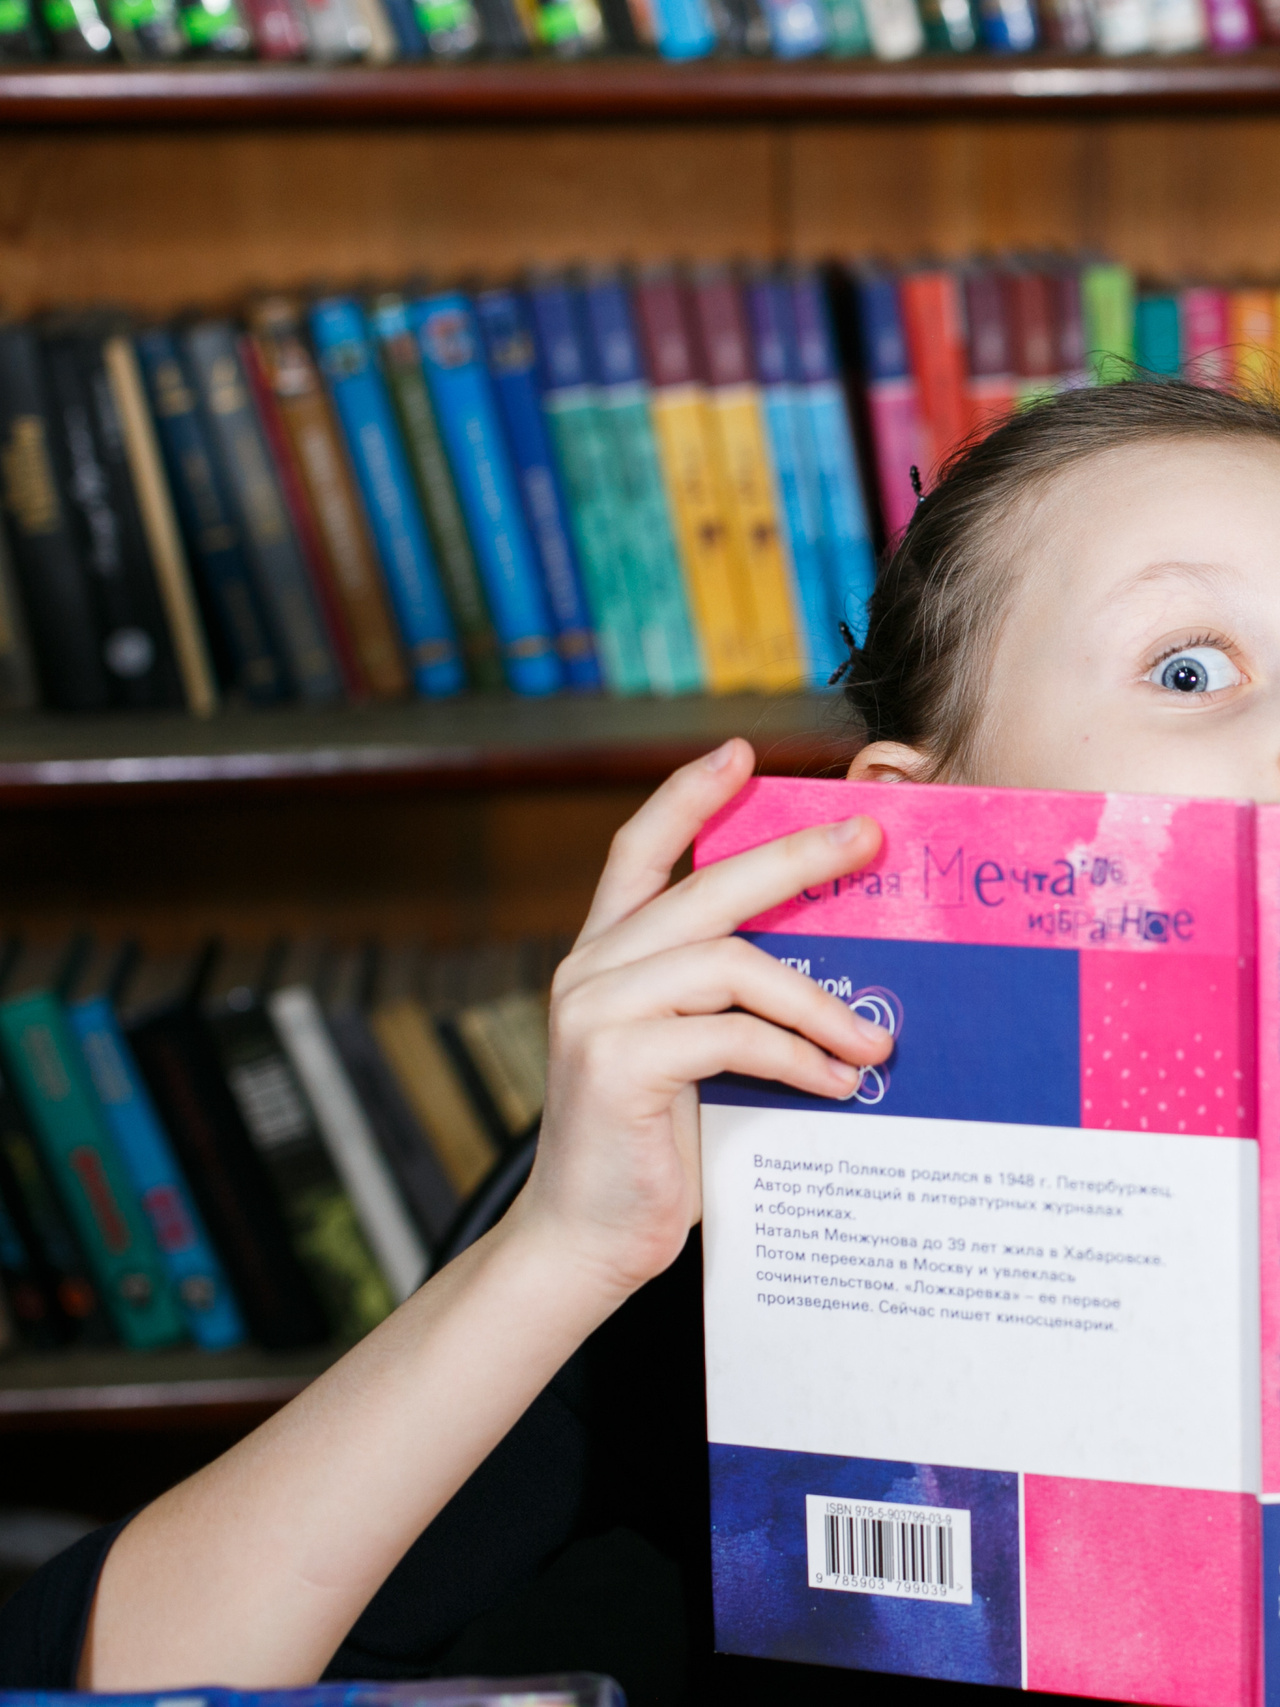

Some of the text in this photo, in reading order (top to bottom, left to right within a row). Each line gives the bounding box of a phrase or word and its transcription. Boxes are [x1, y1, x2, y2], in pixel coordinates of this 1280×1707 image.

[754, 1154, 1173, 1198] Владимир Поляков родился в 1948 г. Петербуржец.
[754, 1177, 1123, 1217] Автор публикаций в литературных журналах
[755, 1201, 857, 1220] и сборниках.
[755, 1222, 1166, 1266] Наталья Менжунова до 39 лет жила в Хабаровске.
[756, 1245, 1076, 1284] Потом переехала в Москву и увлеклась
[756, 1270, 899, 1292] сочинительством.
[905, 1280, 1020, 1302] «Ложкаревка»
[1039, 1294, 1057, 1304] ее
[1062, 1294, 1122, 1310] первое
[757, 1293, 1119, 1333] произведение. Сейчас пишет киносценарии.
[826, 1502, 952, 1526] ISBN 978-5-903799-03-9
[815, 1572, 948, 1597] 9 785903 799039
